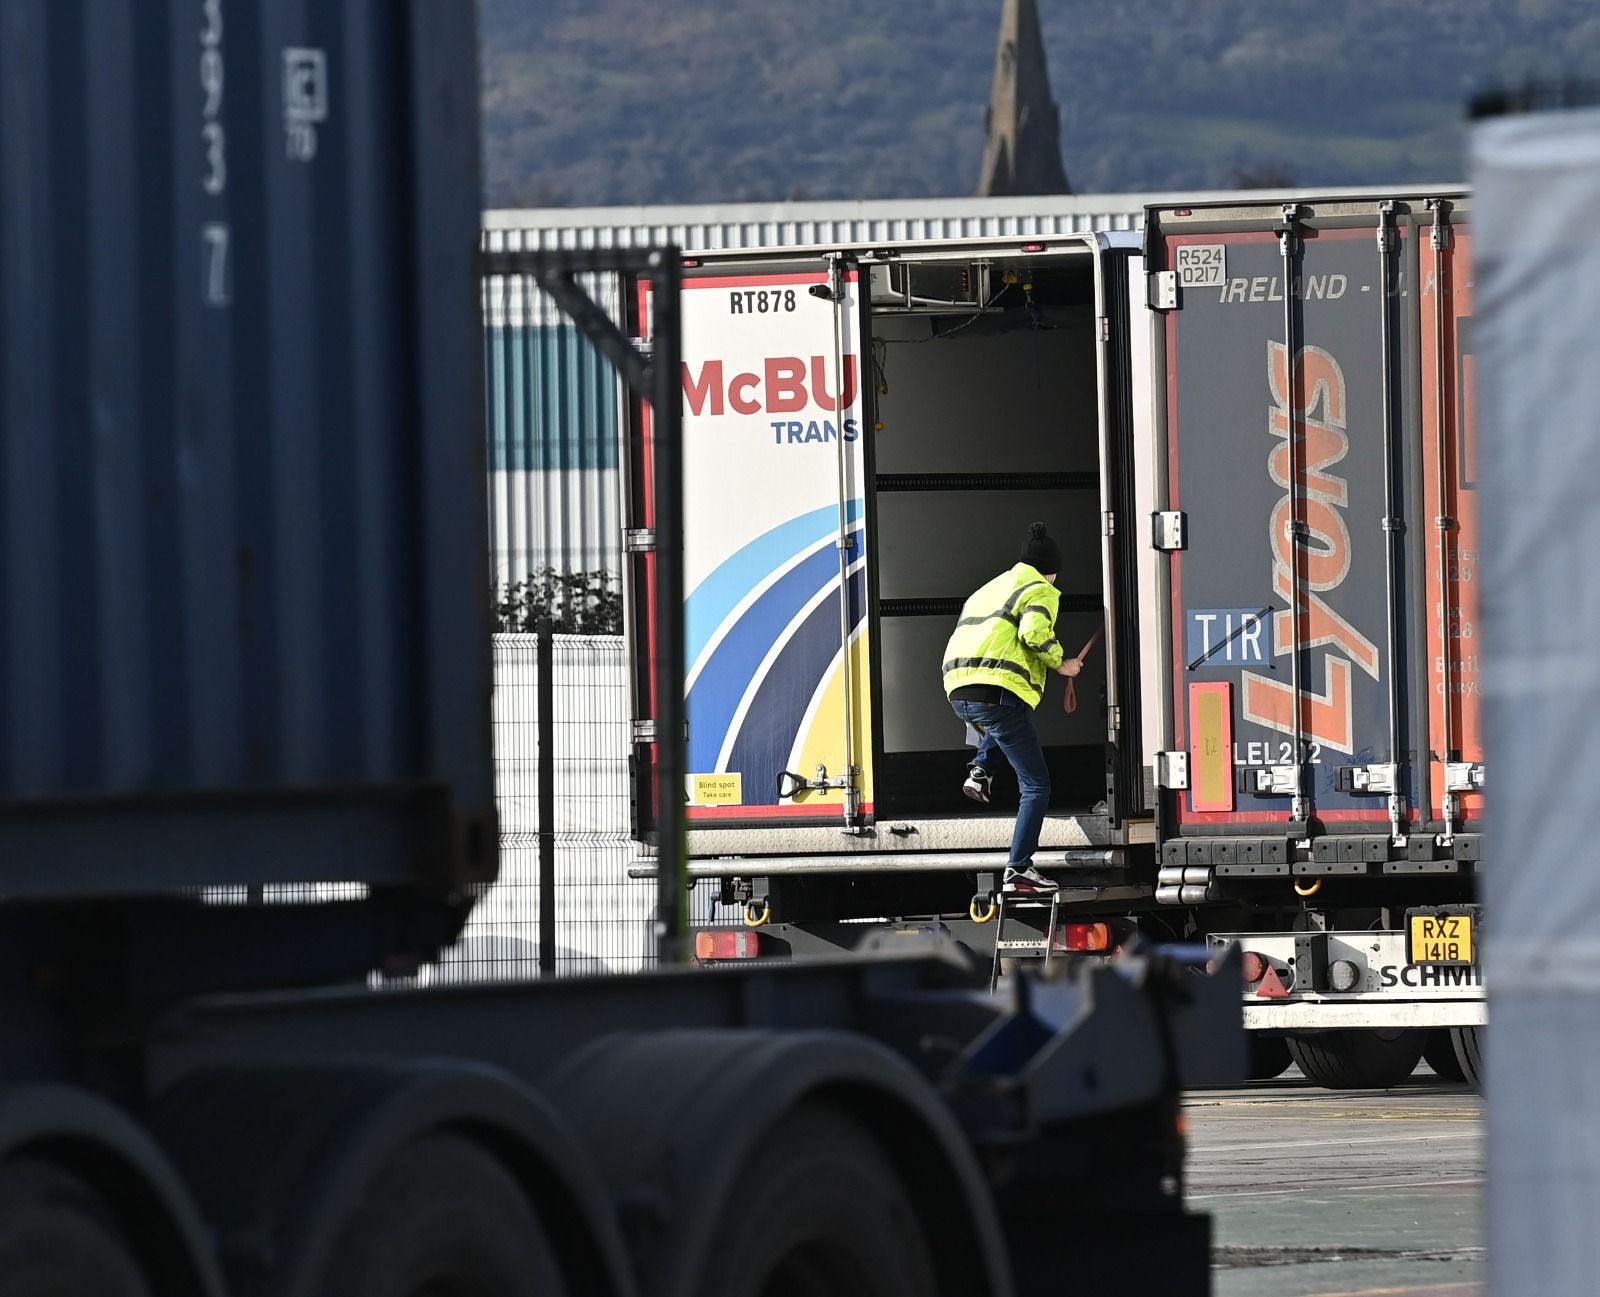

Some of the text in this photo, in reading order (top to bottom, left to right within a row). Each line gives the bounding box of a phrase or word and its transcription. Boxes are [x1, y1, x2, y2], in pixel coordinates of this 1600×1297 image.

[1179, 249, 1222, 265] R524
[1183, 267, 1219, 282] 0217
[1219, 274, 1347, 303] IRELAND
[730, 290, 796, 314] RT878
[680, 354, 858, 416] McBU
[770, 418, 859, 444] TRANS
[1242, 339, 1380, 756] LYONS
[1194, 613, 1262, 661] TIR
[698, 781, 736, 789] Blind spot
[1423, 919, 1460, 939] RXZ
[1425, 942, 1459, 960] 1418
